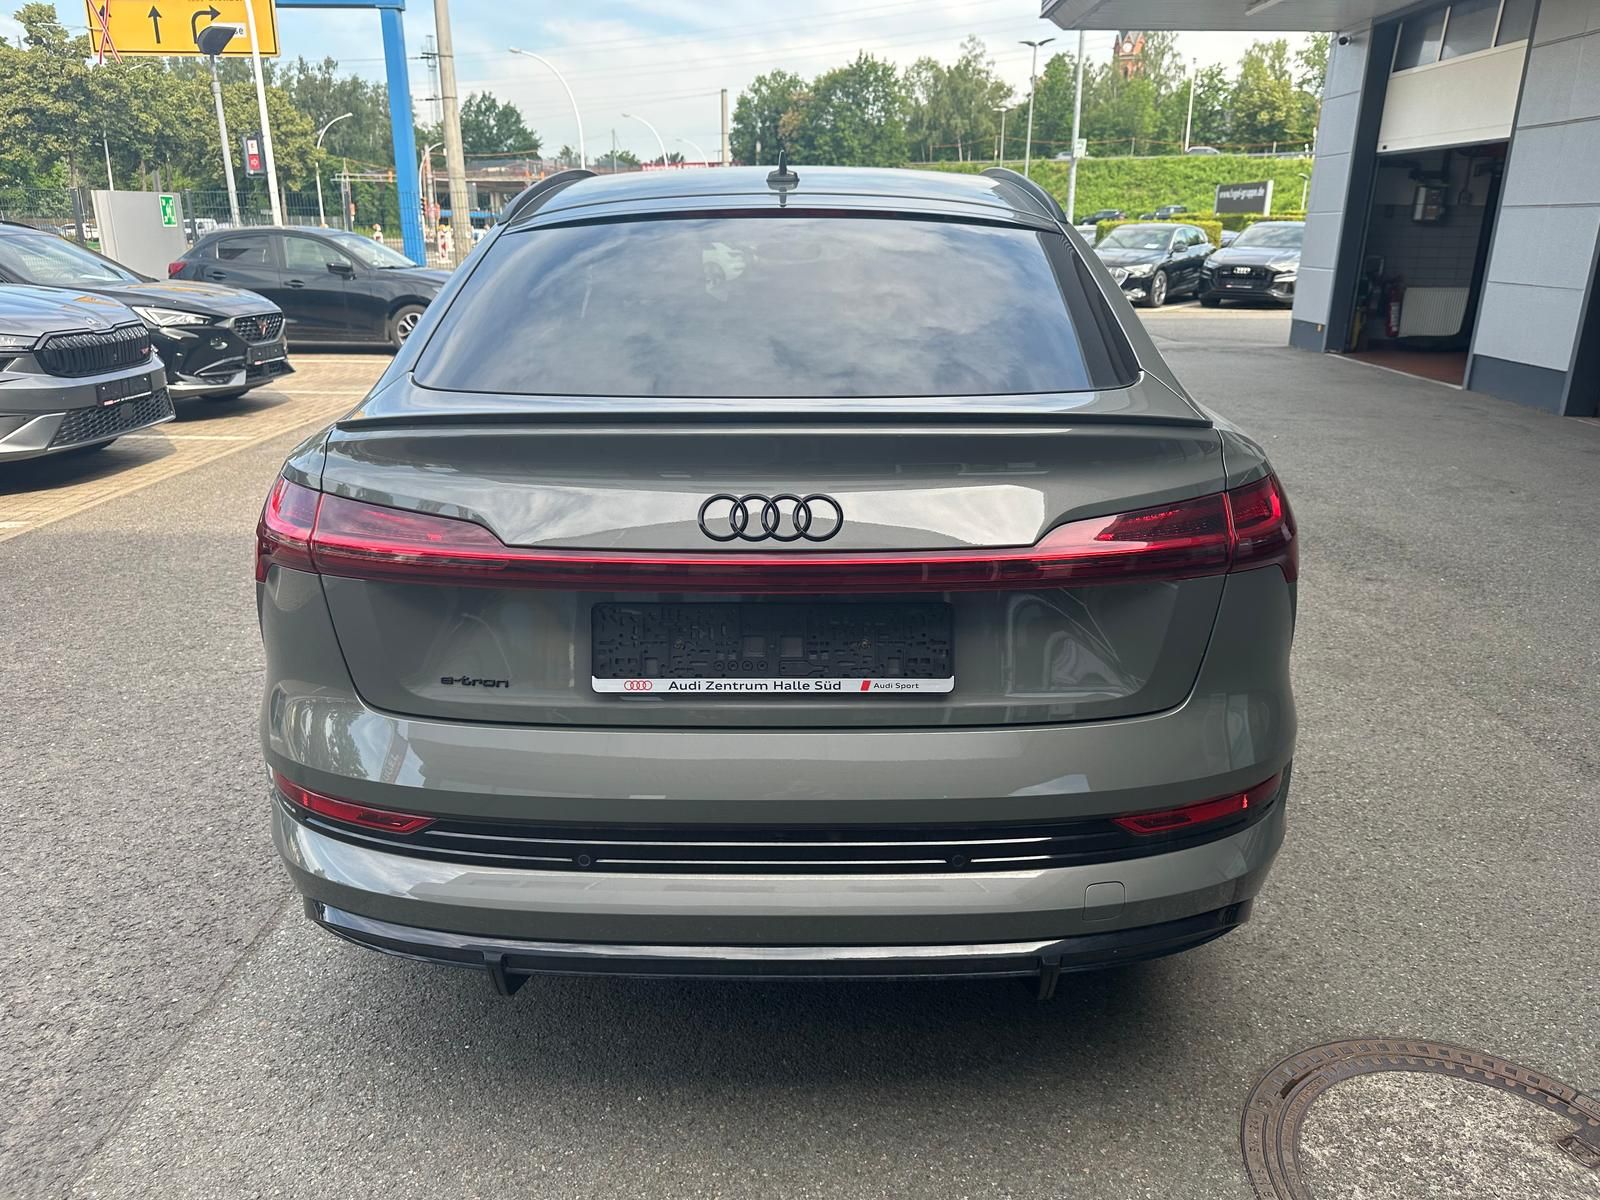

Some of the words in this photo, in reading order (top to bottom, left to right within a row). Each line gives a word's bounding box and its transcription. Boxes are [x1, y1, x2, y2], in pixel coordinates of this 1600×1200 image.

[440, 675, 509, 689] e-tron
[668, 680, 701, 691] Audi
[705, 680, 769, 691] Zentrum
[773, 680, 811, 691] Halle
[814, 680, 842, 691] Süd
[873, 682, 893, 690] Audi
[895, 682, 920, 691] Sport
